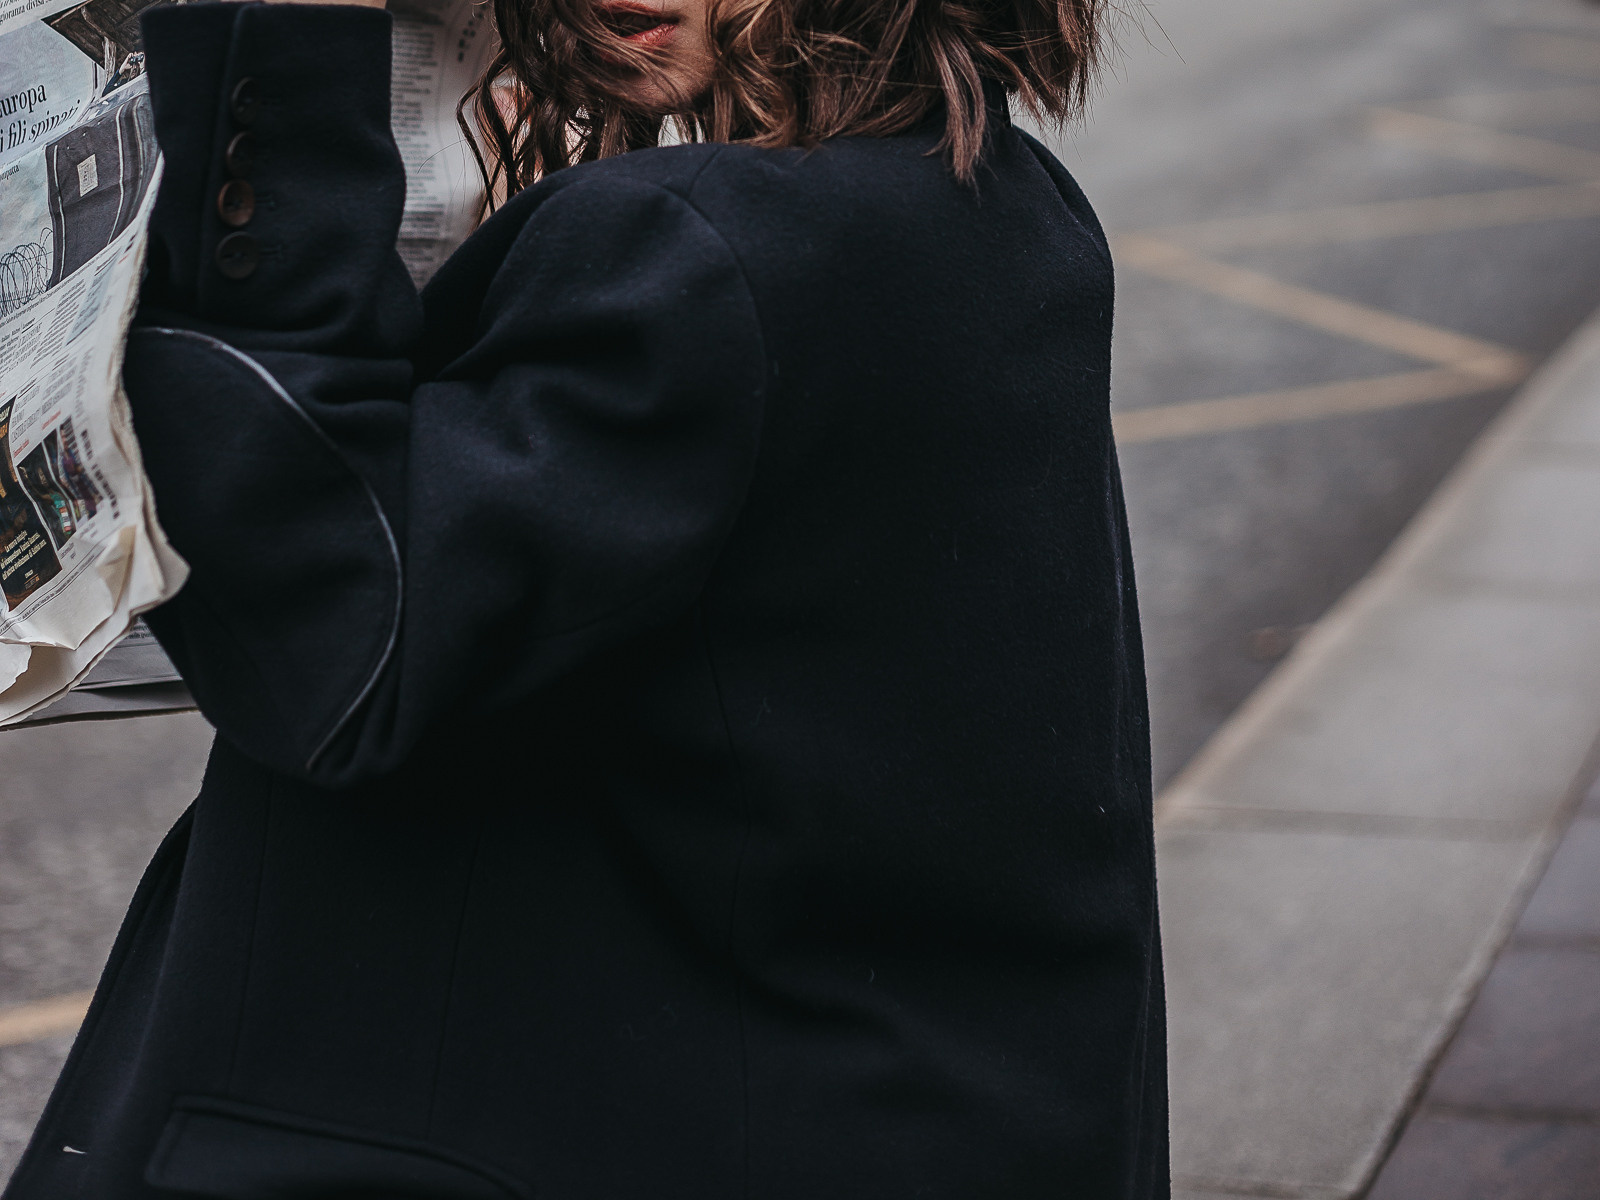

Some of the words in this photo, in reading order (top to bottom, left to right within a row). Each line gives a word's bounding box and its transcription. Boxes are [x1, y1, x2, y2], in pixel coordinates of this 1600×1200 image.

[0, 85, 47, 118] uropa
[7, 120, 27, 150] fili
[29, 99, 81, 143] spinati
